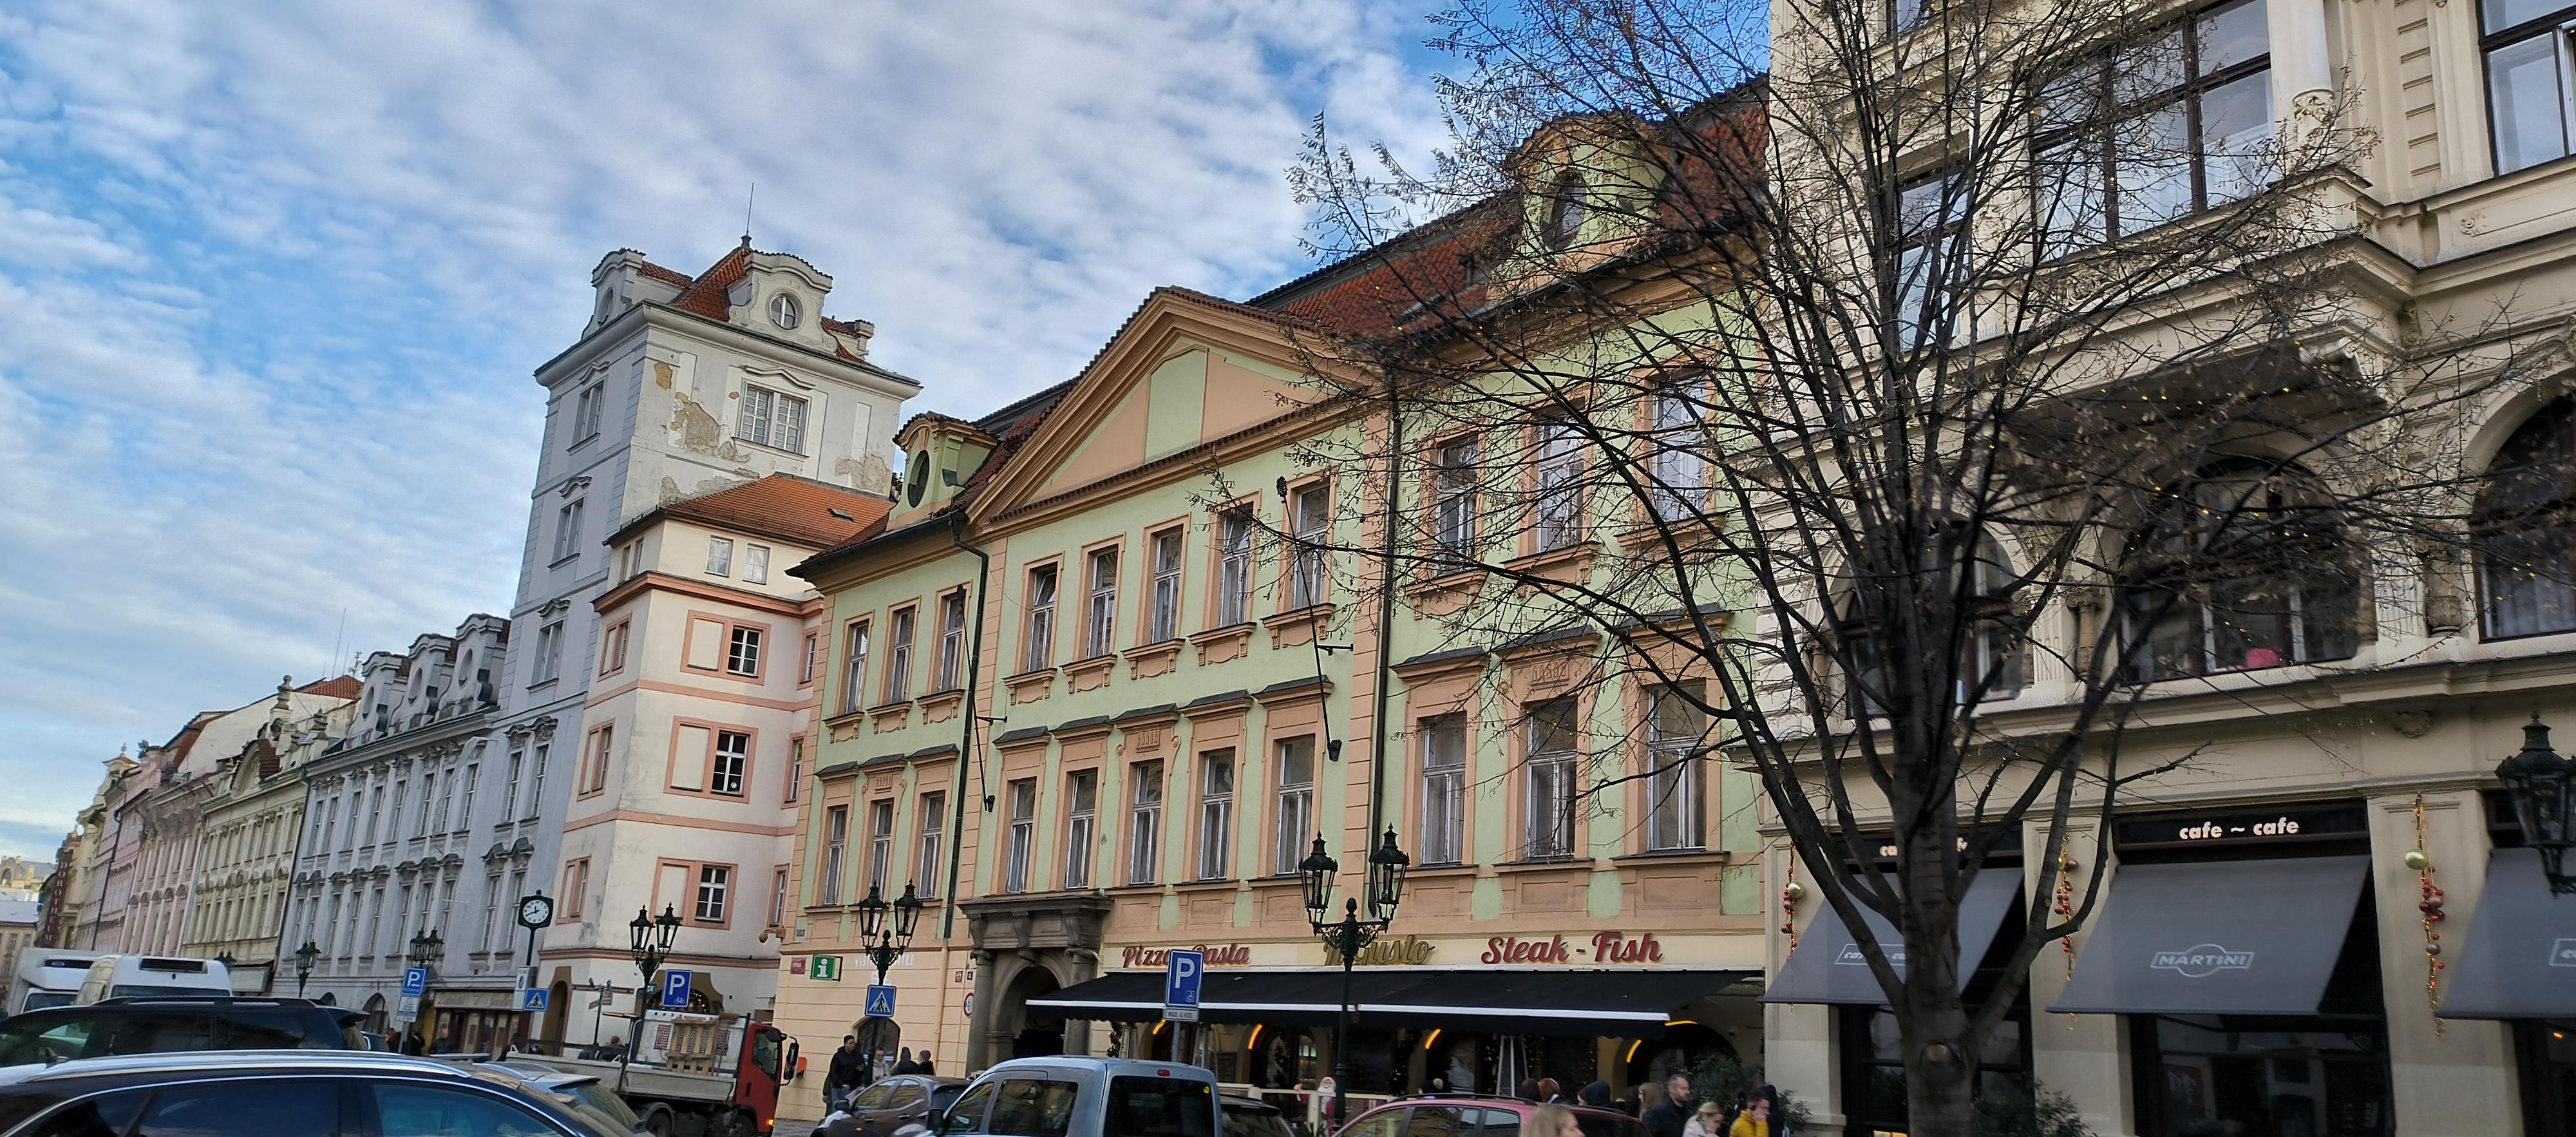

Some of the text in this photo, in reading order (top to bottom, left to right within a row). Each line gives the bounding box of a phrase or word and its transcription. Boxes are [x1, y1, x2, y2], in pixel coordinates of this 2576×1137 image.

[2179, 821, 2223, 840] cafe
[2253, 816, 2300, 836] cafe
[1481, 934, 1570, 964] Steak
[1592, 930, 1663, 962] Fish
[2158, 955, 2248, 966] MARTINI
[406, 971, 421, 987] P
[1174, 957, 1195, 989] P
[668, 974, 686, 995] P
